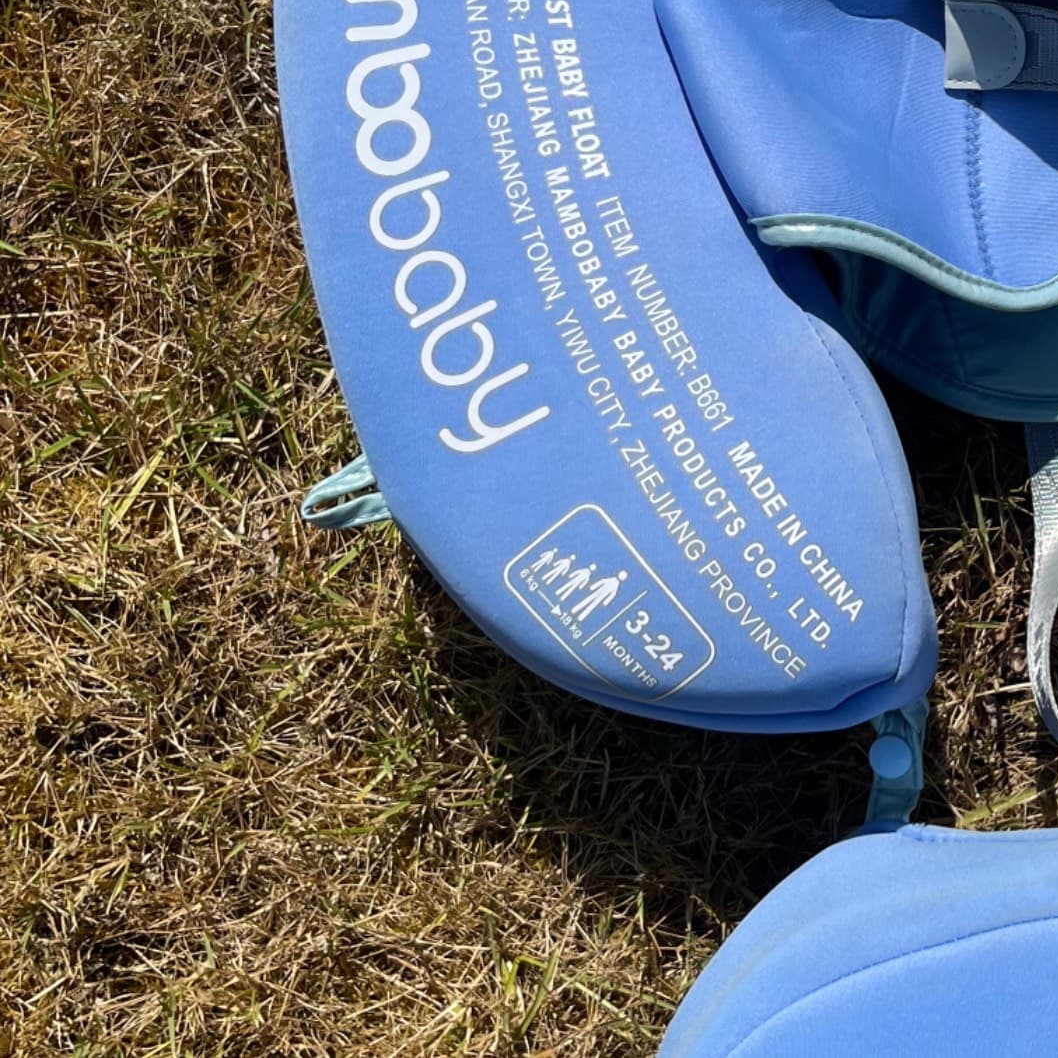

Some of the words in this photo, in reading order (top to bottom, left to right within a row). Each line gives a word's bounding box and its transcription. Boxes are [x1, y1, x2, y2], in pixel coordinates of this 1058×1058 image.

[552, 38, 589, 97] BABY
[568, 107, 610, 179] FLOAT
[596, 196, 640, 258] ITEM
[513, 32, 561, 157] ZHEJIANG
[545, 166, 628, 323] MAMBOBABY
[613, 330, 664, 397] BABY
[653, 403, 747, 538] PRODUCTS
[743, 542, 779, 599] CO.,
[787, 597, 832, 649] LTD.
[626, 263, 698, 376] NUMBER:
[470, 28, 503, 109] ROAD,
[487, 112, 537, 224] SHANGXI
[521, 224, 566, 311] TOWN,
[556, 308, 602, 375] YIWU
[588, 376, 633, 444] CITY,
[621, 439, 707, 561] ZHEJIANG
[699, 559, 807, 679] PROVINCE
[687, 373, 735, 432] B661
[728, 440, 788, 518] MADE
[776, 513, 809, 546] IN
[524, 575, 539, 592] kg
[800, 544, 865, 622] CHINA
[559, 612, 572, 626] 18
[567, 622, 584, 639] kg
[625, 610, 684, 672] 3-24
[603, 635, 658, 688] MONTHS
